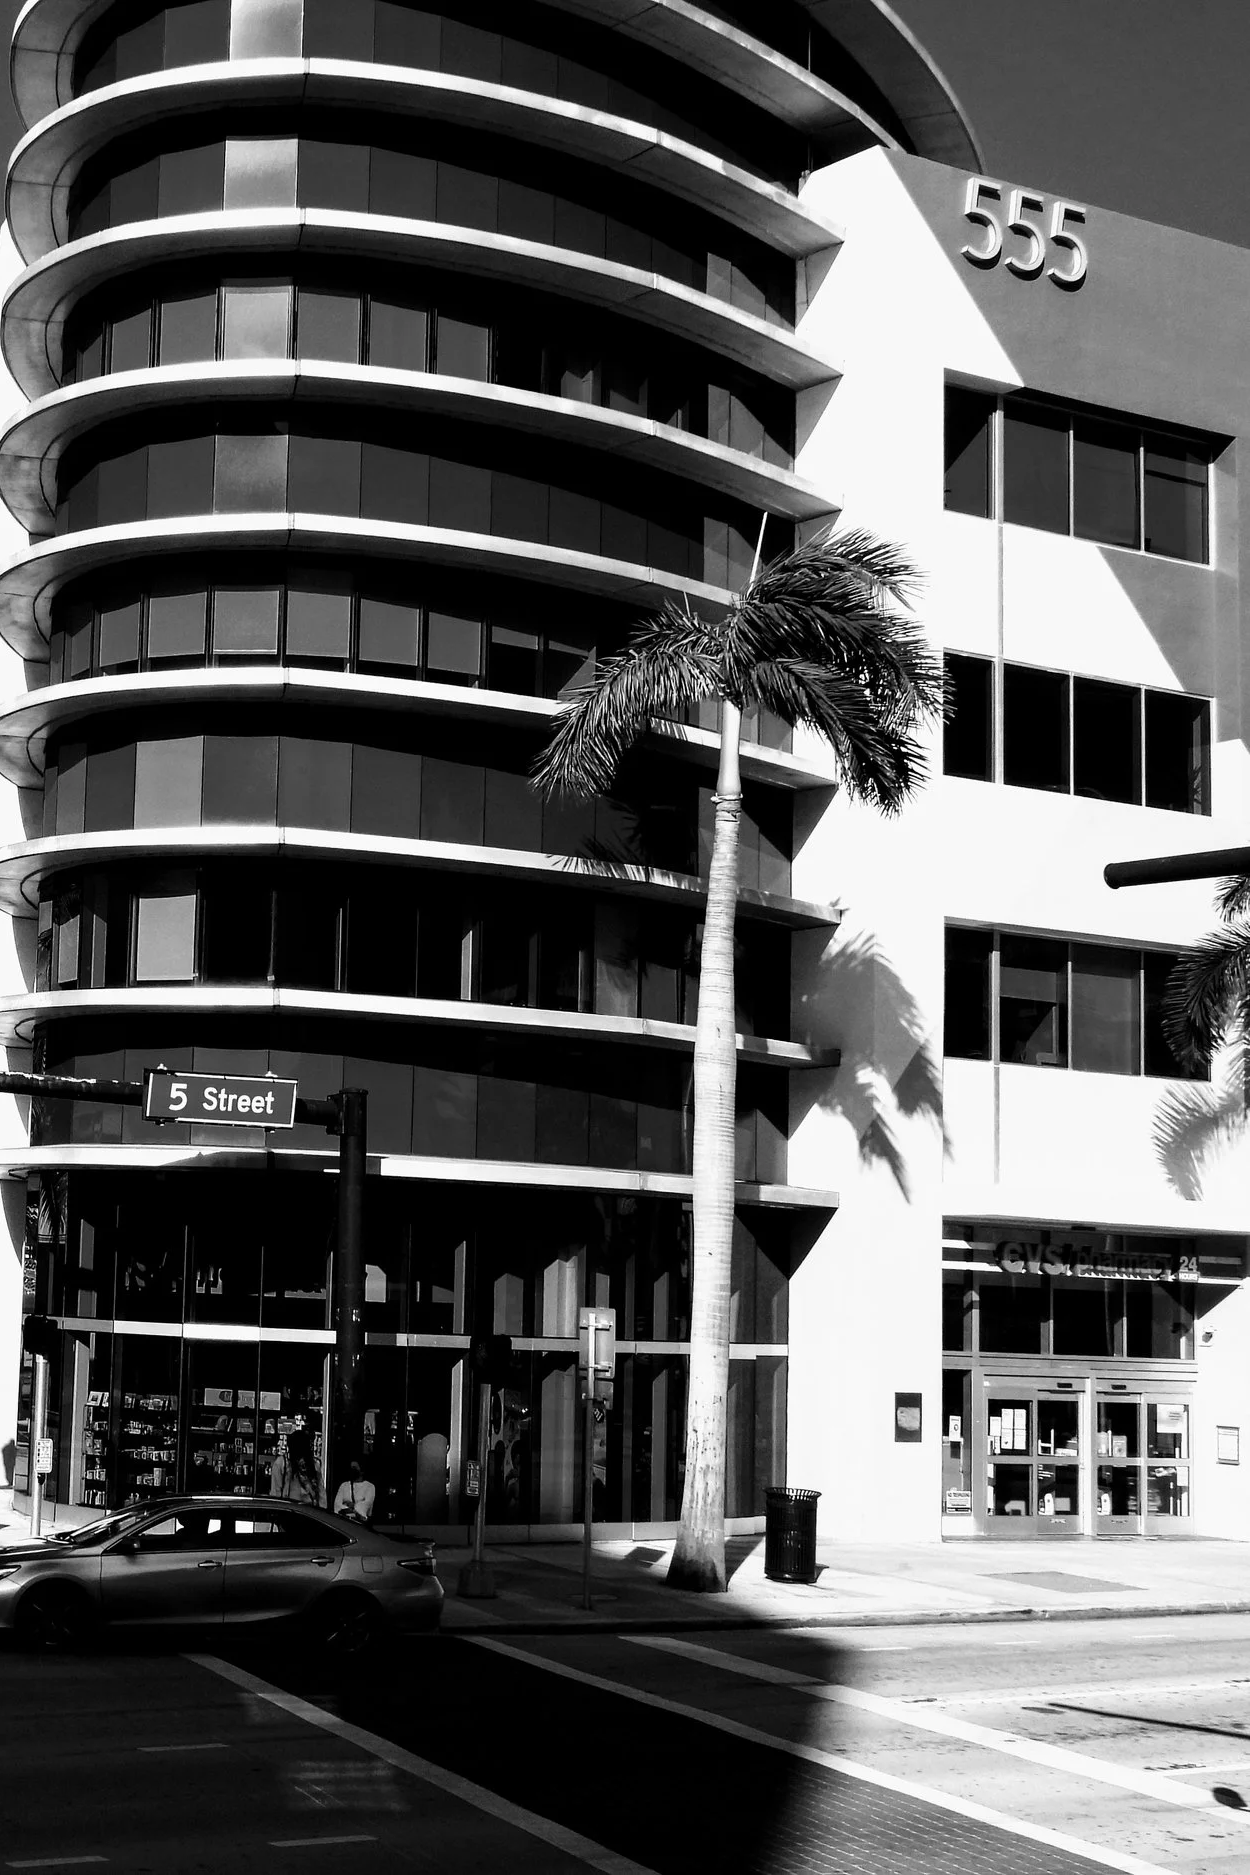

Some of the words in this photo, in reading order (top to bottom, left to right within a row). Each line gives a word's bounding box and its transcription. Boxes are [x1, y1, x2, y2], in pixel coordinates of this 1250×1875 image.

[961, 177, 1088, 284] 555
[168, 1082, 188, 1111] 5
[202, 1086, 275, 1115] Street
[1180, 1255, 1198, 1271] 24
[1179, 1272, 1199, 1281] HOURS
